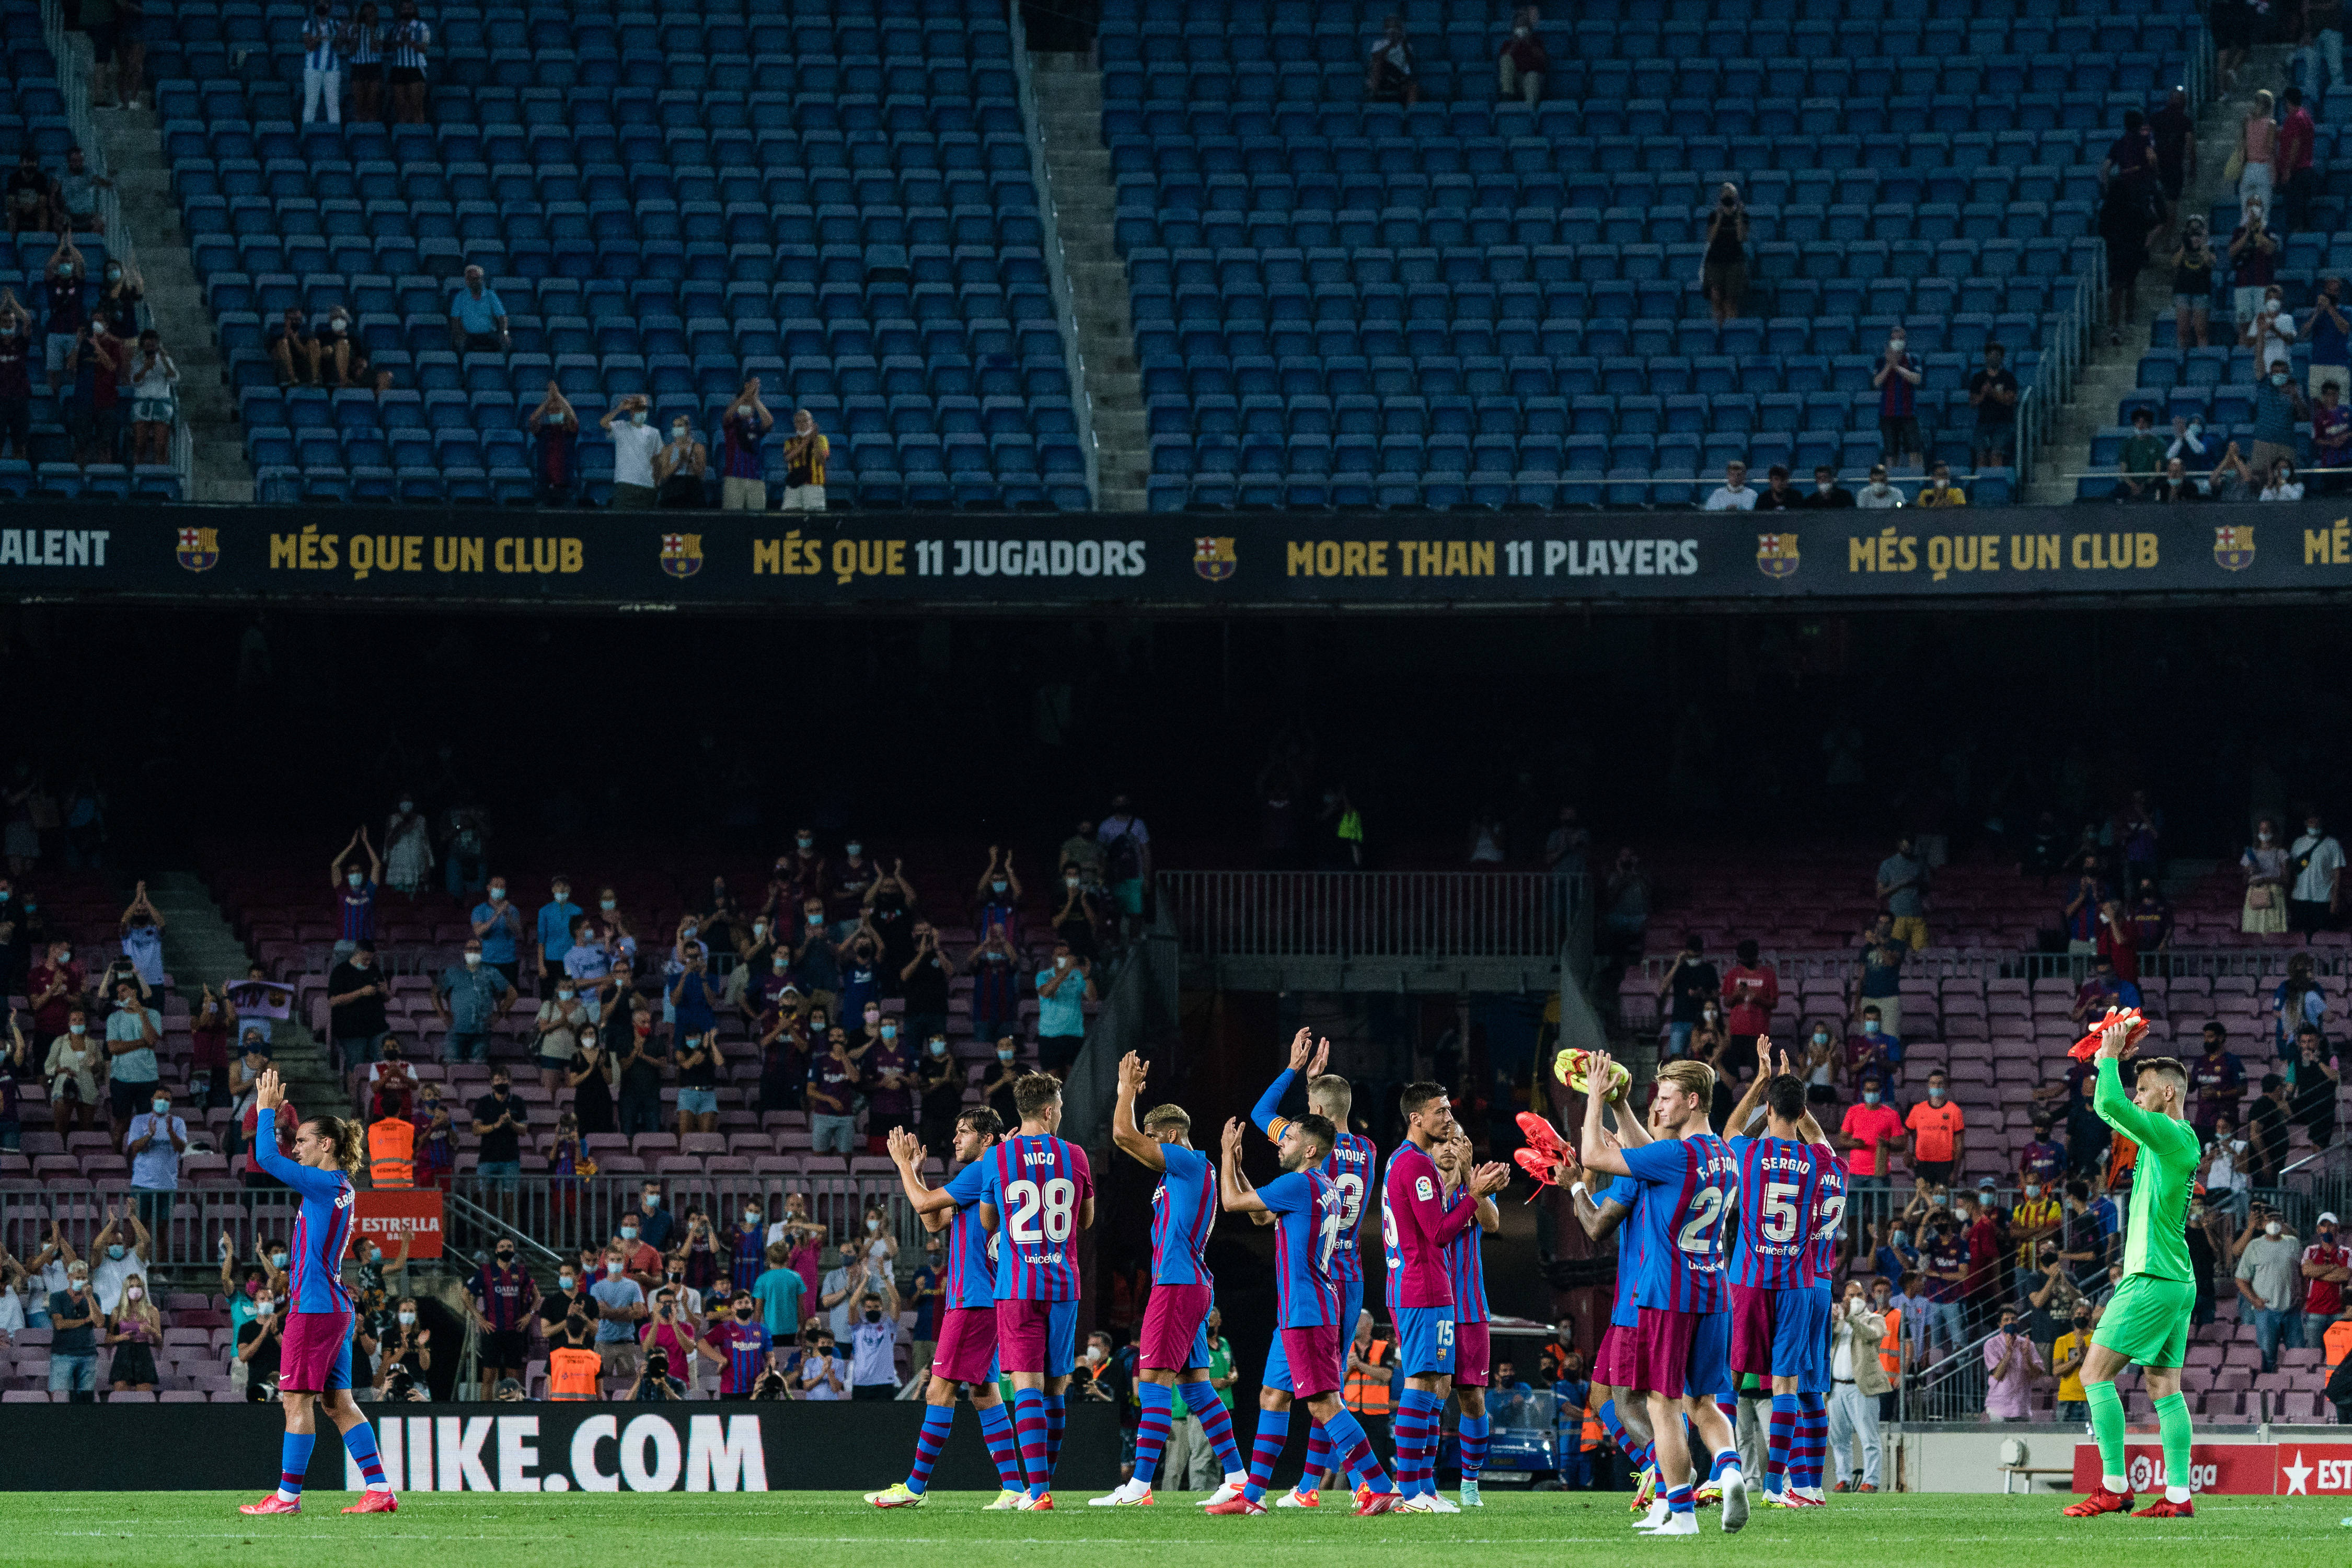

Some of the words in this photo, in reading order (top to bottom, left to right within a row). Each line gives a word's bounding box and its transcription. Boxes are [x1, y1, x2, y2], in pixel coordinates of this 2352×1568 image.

[1, 529, 109, 566] ALENT
[270, 524, 339, 570] MÉS
[349, 535, 423, 580] QUE
[434, 536, 484, 572] UN
[495, 537, 583, 573] CLUB
[753, 529, 822, 574] MÉS
[832, 539, 906, 585] QUE
[915, 540, 943, 575] 11
[953, 540, 1146, 576] JUGADORS
[1287, 540, 1388, 577] MORE
[1398, 541, 1495, 576] THAN
[1505, 540, 1533, 576] 11
[1544, 539, 1698, 575] PLAYERS
[1849, 527, 1917, 572] MÉS
[1928, 535, 2000, 581] QUE
[2011, 534, 2060, 571] UN
[2072, 533, 2159, 569] CLUB
[1023, 1151, 1055, 1167] NICO
[1334, 1148, 1367, 1165] PIQUÉ
[1708, 1159, 1721, 1173] DE
[1761, 1157, 1811, 1174] SERGIO
[1005, 1178, 1075, 1244] 28
[1334, 1173, 1364, 1230] 3
[1678, 1186, 1738, 1253] 21
[1761, 1182, 1800, 1242] 5
[362, 1217, 440, 1232] ESTRELLA
[1024, 1252, 1053, 1264] unicef
[1755, 1244, 1788, 1256] unicef
[1436, 1320, 1454, 1346] 15
[345, 1413, 770, 1492] NIKE.COM
